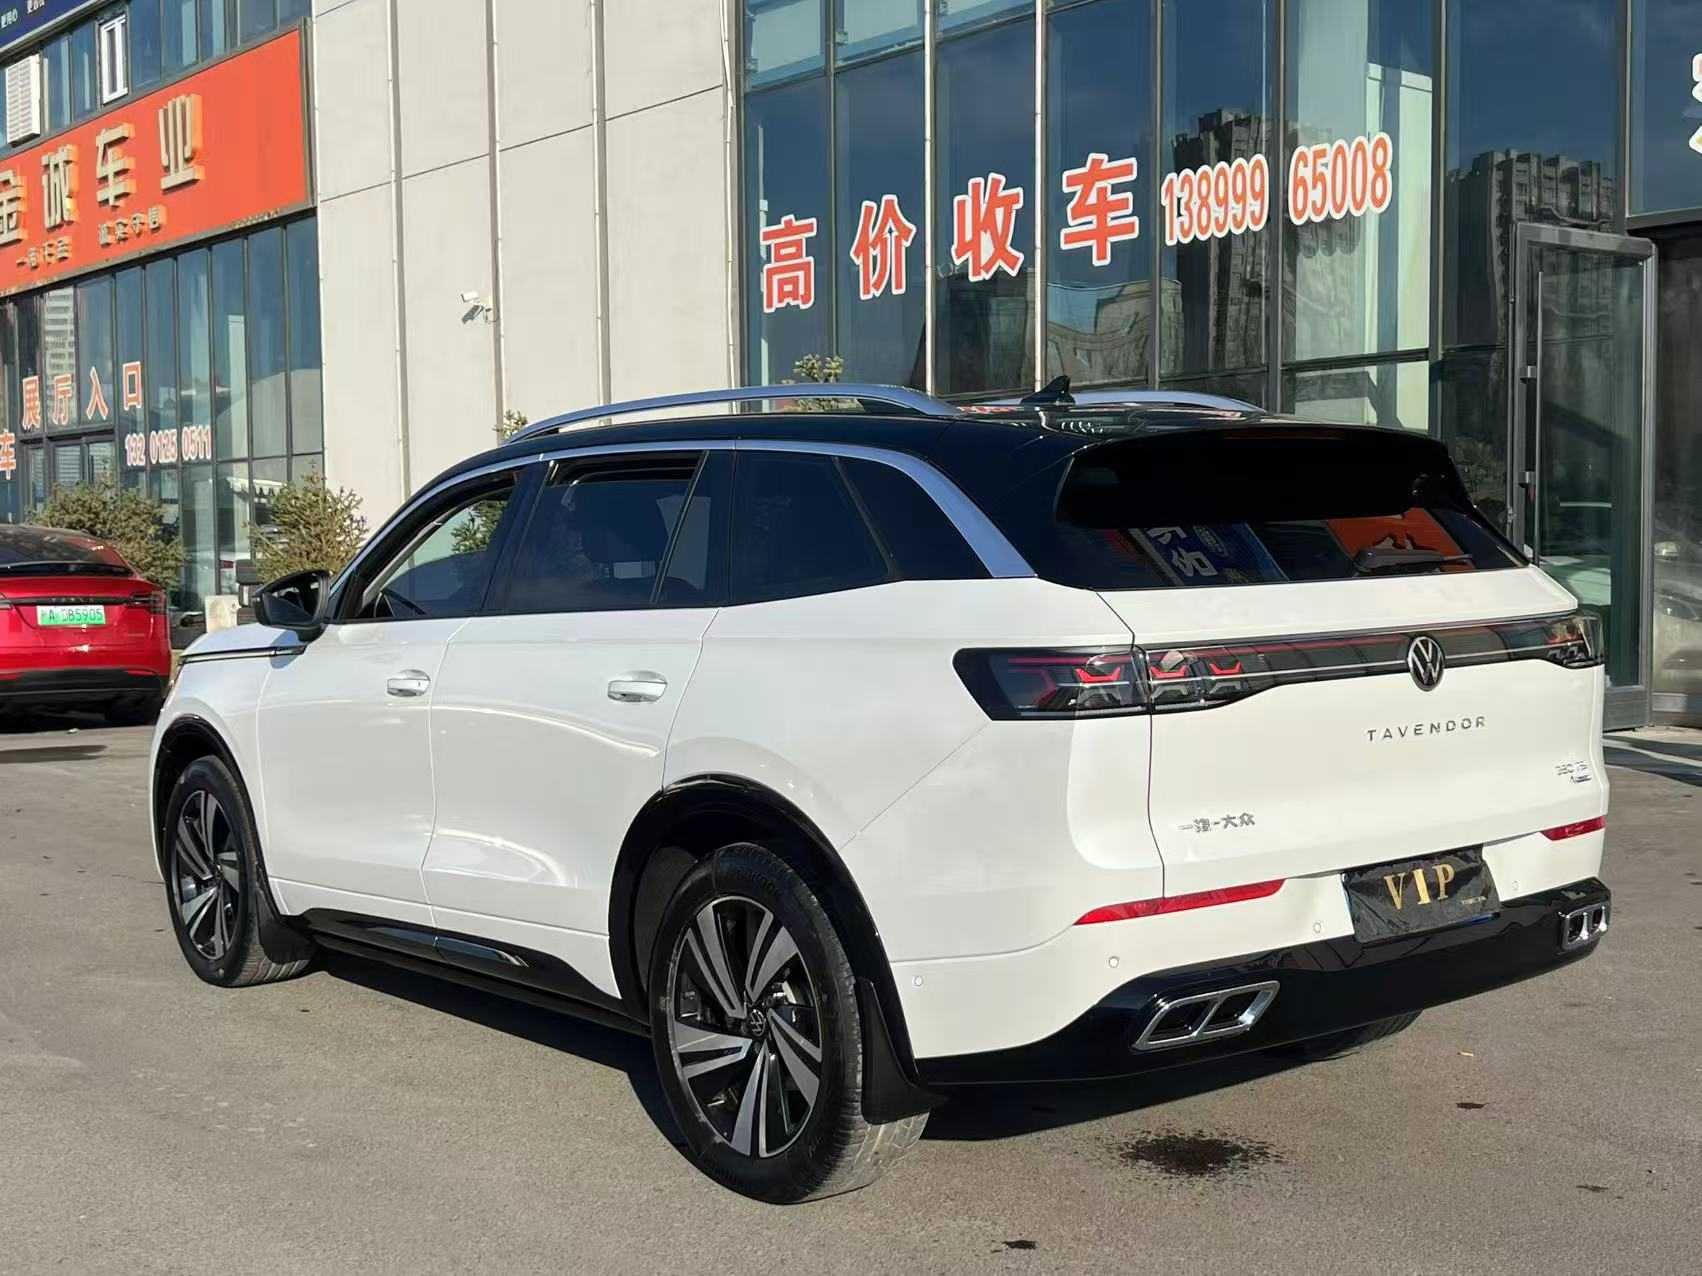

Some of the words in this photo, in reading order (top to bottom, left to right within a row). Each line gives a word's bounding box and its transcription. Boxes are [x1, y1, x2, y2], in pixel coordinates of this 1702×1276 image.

[760, 153, 1139, 313] 高价收车
[1161, 154, 1269, 246] 138999
[1289, 132, 1392, 225] 65008
[22, 361, 142, 430] 展厅入口
[1367, 716, 1485, 742] TAVENDOR
[1384, 863, 1455, 911] VIP
